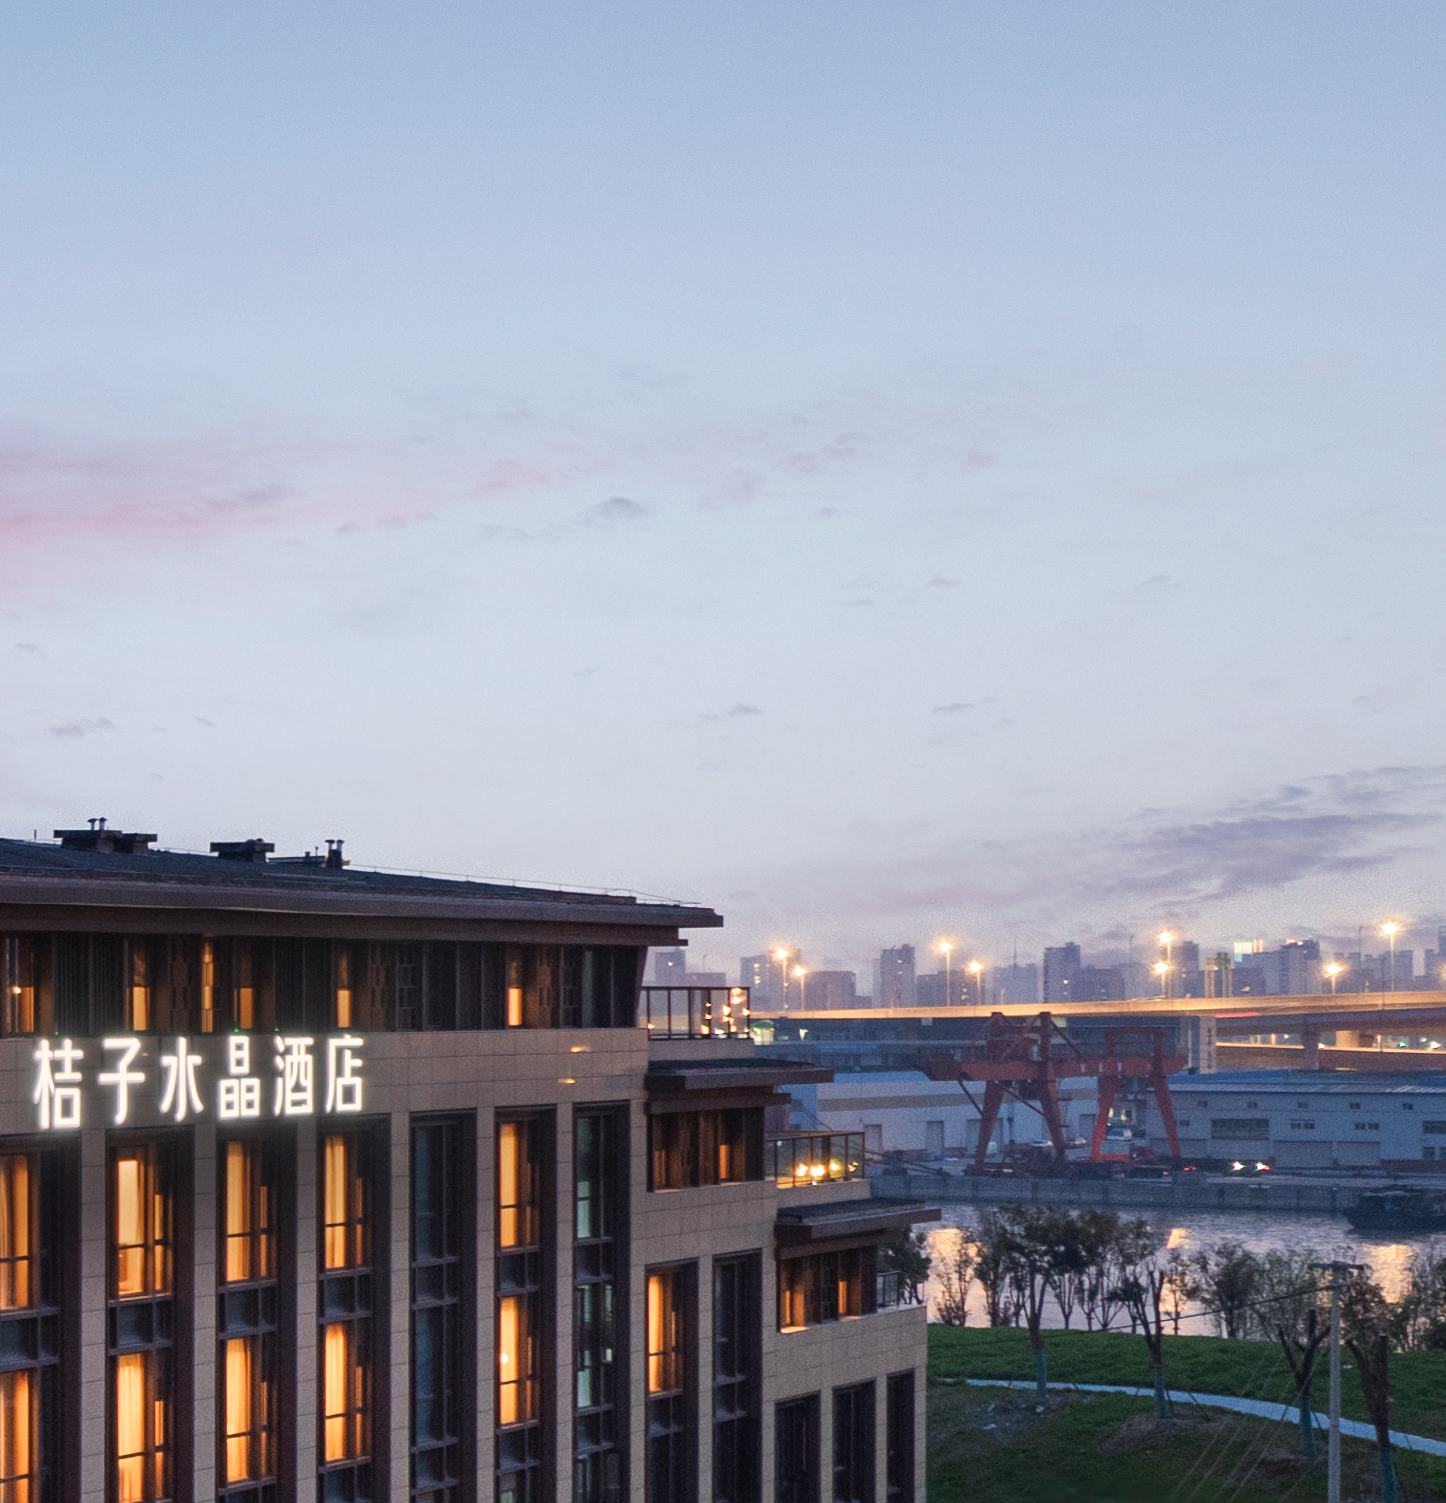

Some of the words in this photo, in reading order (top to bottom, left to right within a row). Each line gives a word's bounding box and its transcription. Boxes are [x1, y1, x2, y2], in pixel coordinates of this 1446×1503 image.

[32, 1033, 365, 1130] 桔子水晶酒店
